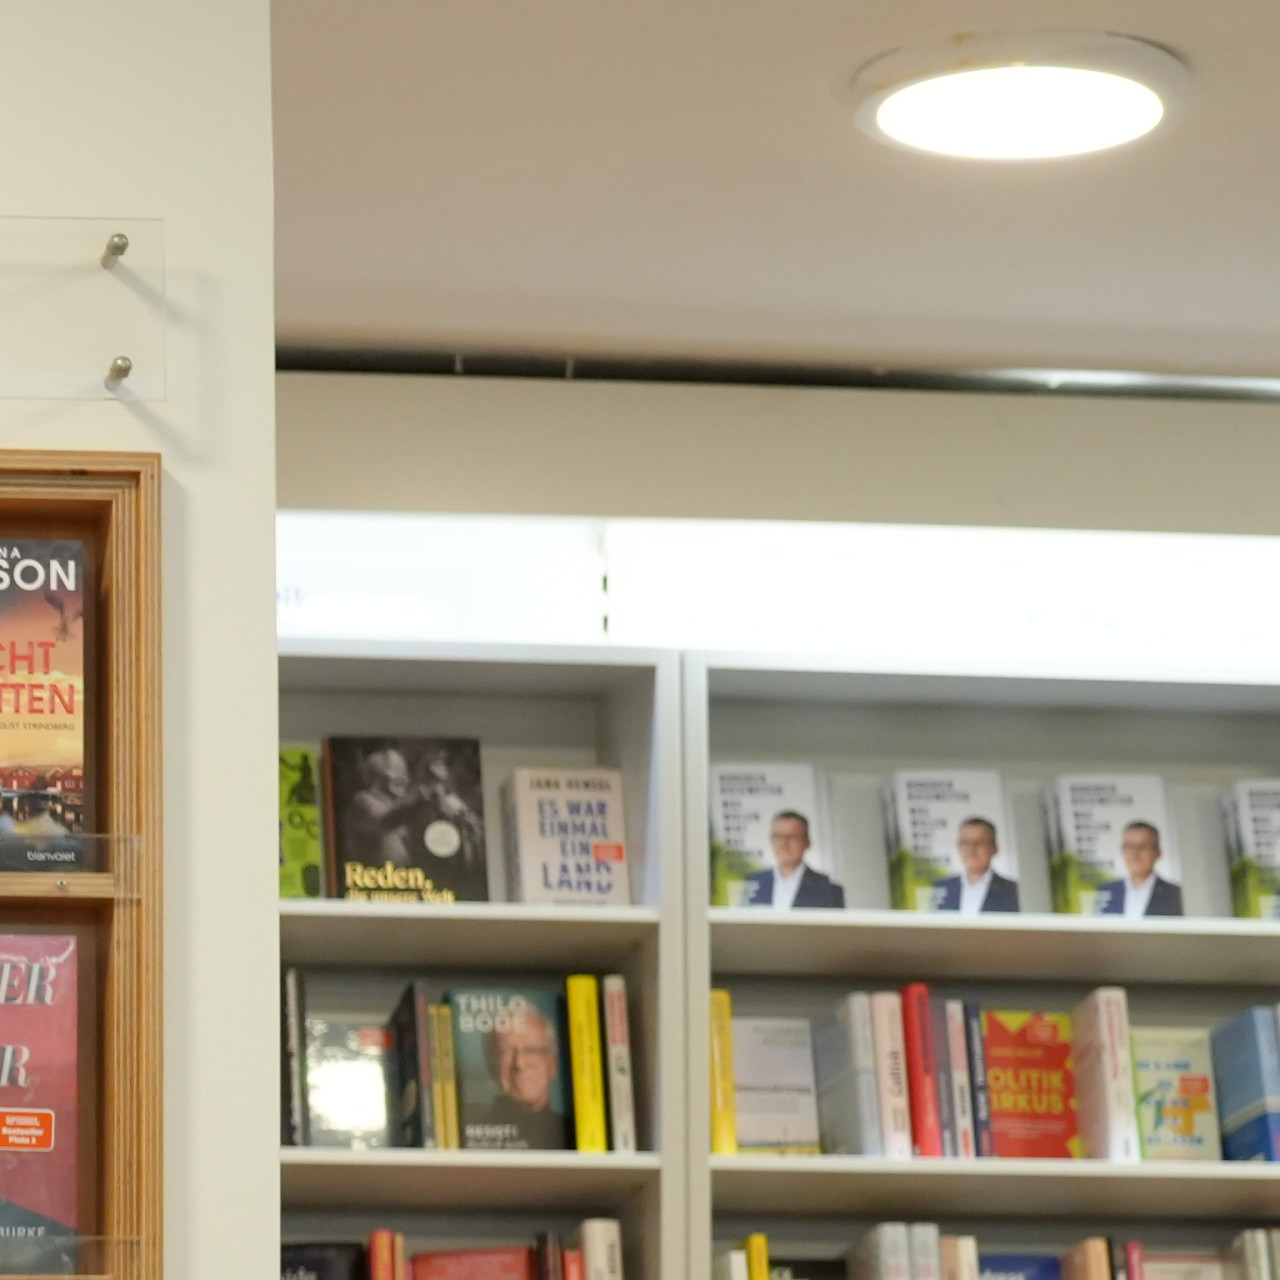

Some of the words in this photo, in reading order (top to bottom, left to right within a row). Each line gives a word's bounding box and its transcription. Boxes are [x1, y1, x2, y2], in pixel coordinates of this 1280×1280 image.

[566, 800, 607, 816] WAR
[538, 820, 610, 839] EINMAL
[344, 860, 434, 890] Reden,
[455, 992, 527, 1013] THILO
[458, 1013, 527, 1034] BODE
[988, 1067, 1066, 1092] OLITIK
[989, 1092, 1065, 1115] IRKUS
